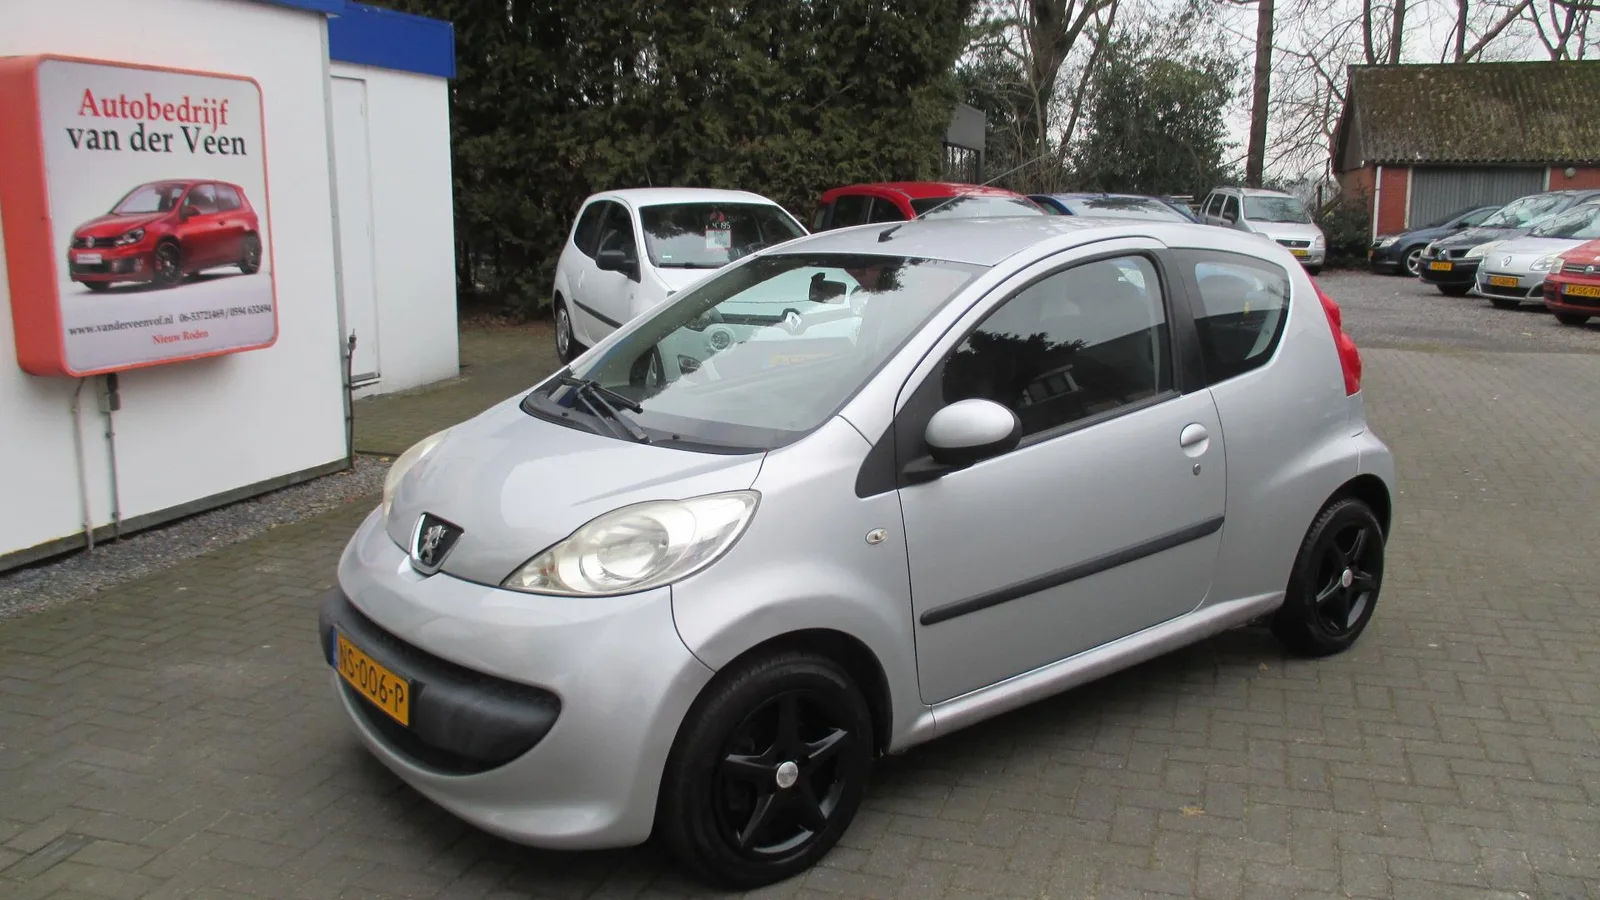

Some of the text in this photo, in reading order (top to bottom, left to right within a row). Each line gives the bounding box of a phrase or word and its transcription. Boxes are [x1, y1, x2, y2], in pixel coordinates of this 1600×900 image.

[78, 88, 228, 132] Autobedrijf
[67, 123, 247, 155] van der Veen
[68, 314, 174, 336] www.vanderveenvof.nl
[152, 330, 209, 345] Nieuw Roden
[339, 642, 404, 713] NS-006-P
